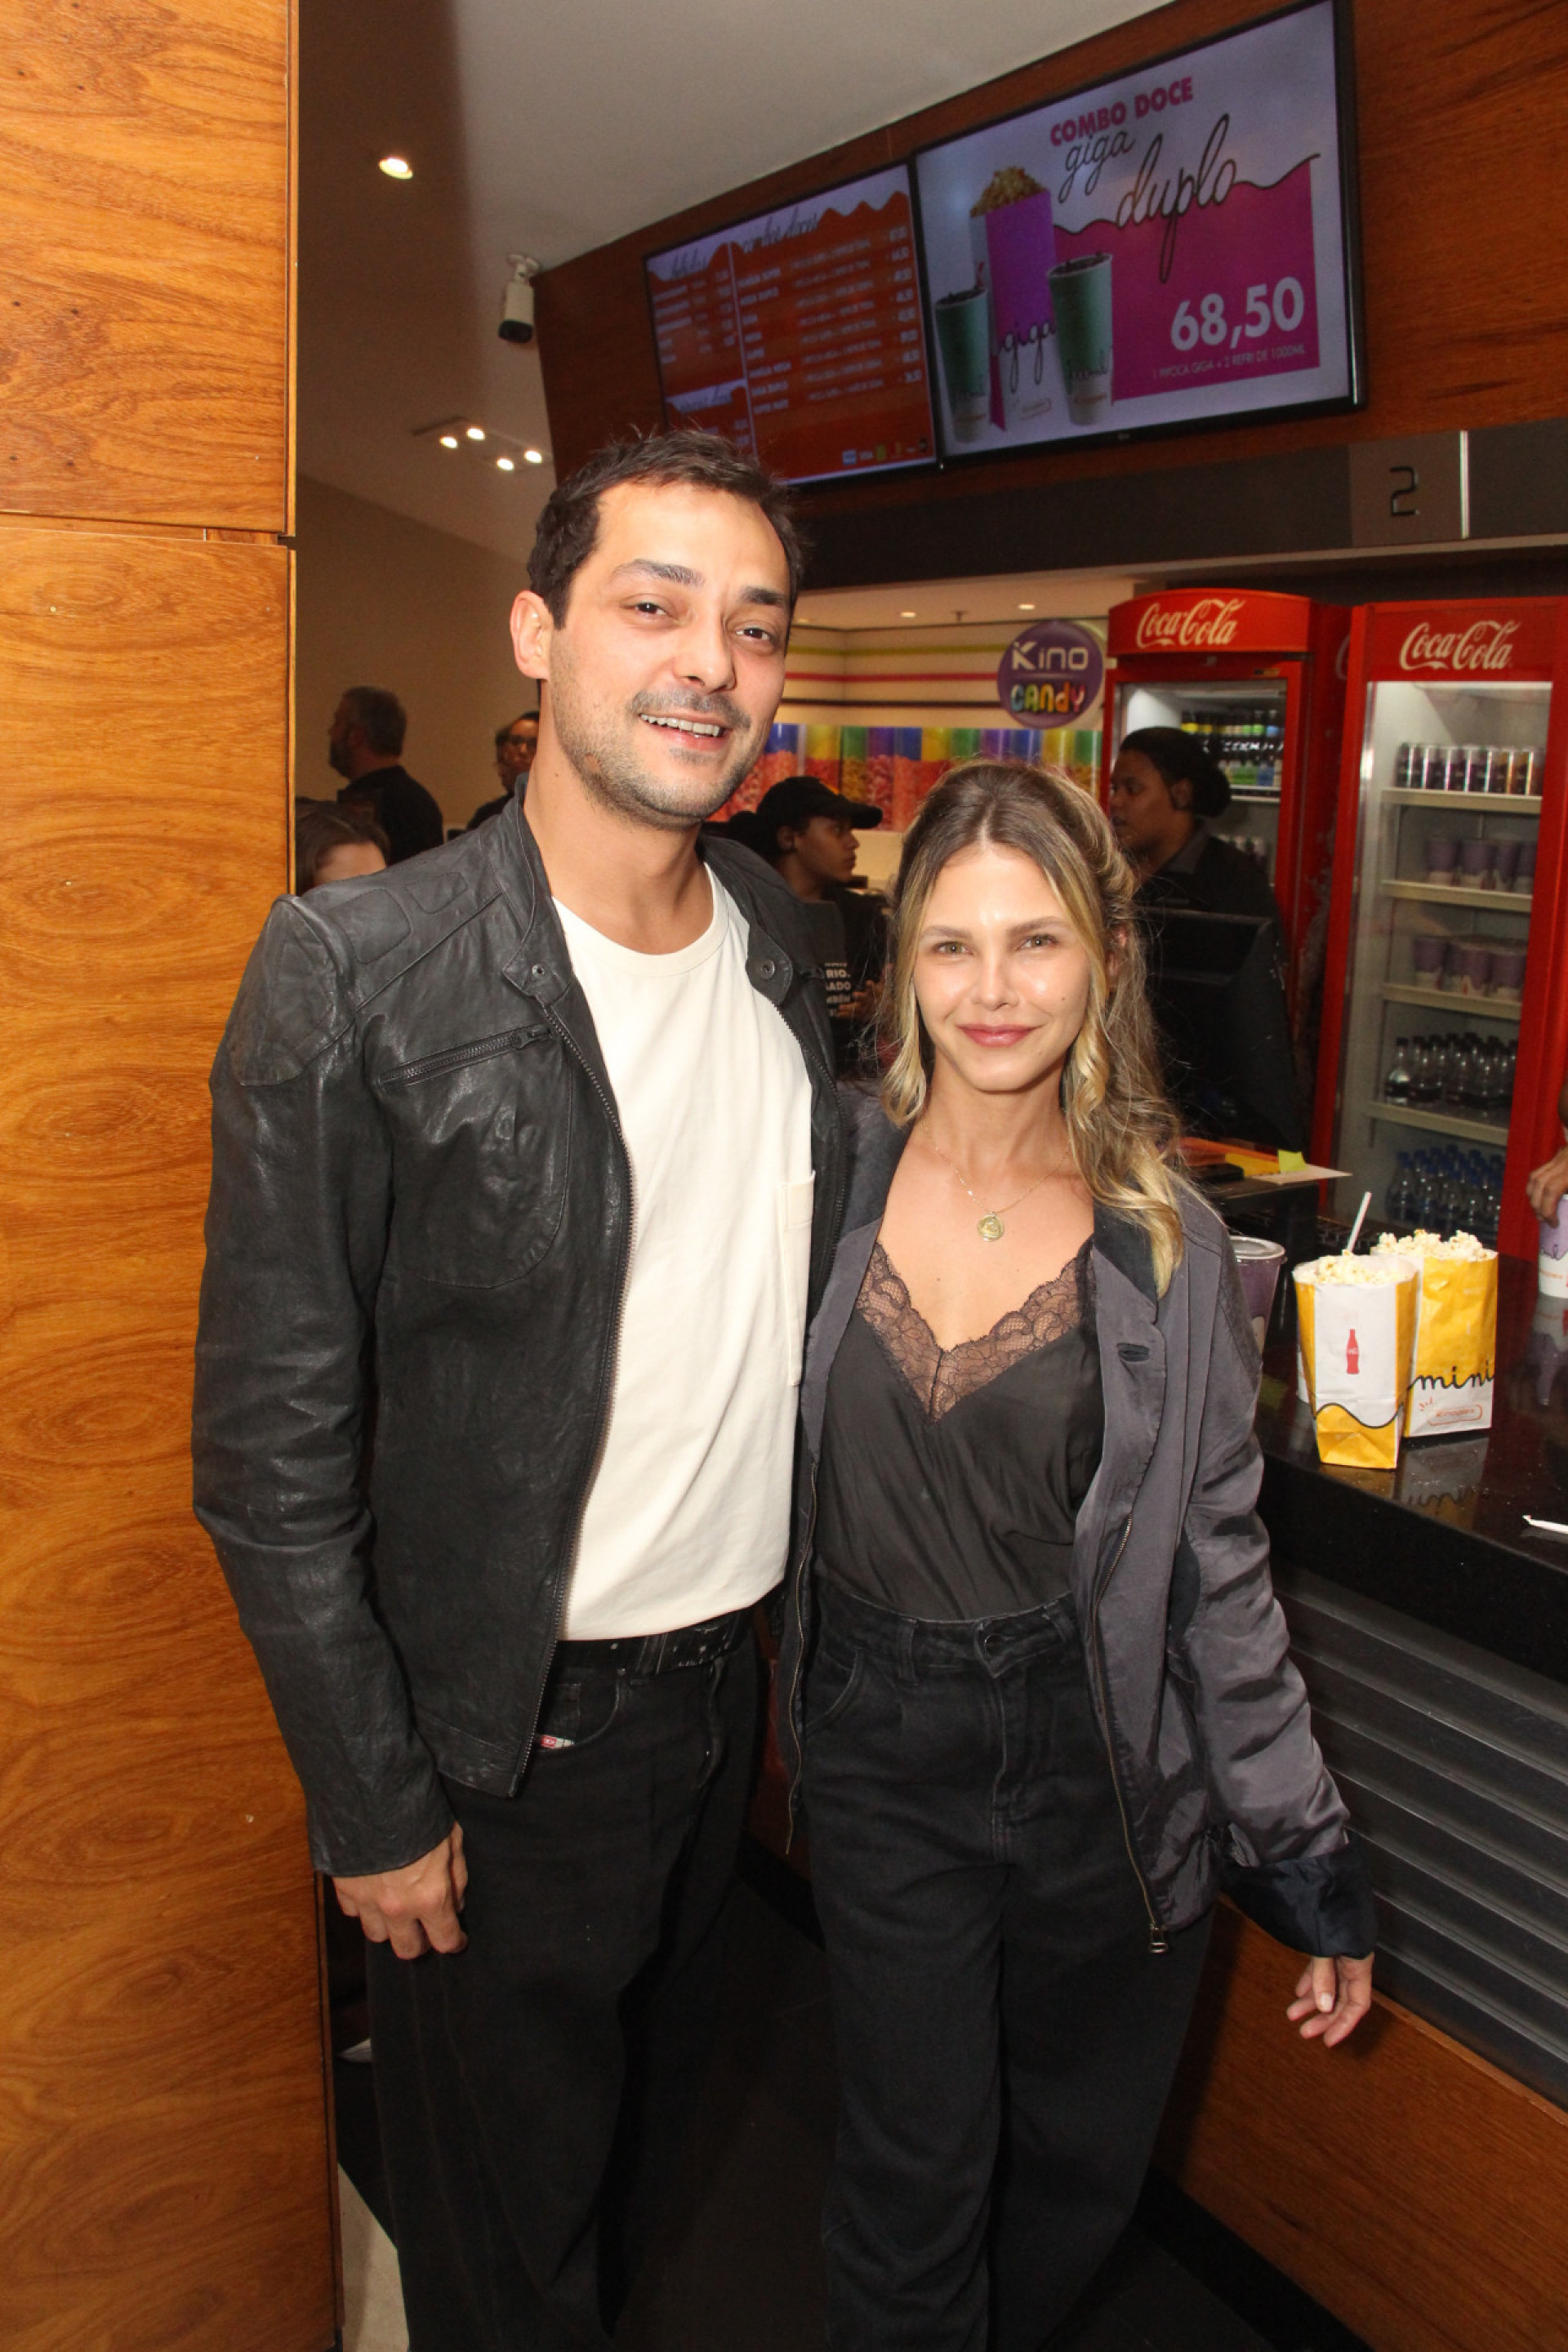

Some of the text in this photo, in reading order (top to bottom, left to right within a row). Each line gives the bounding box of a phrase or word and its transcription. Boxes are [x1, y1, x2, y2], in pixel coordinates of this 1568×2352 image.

[1050, 77, 1194, 147] COMBO DOCE
[1058, 129, 1135, 203] giga
[1116, 113, 1238, 283] duplo
[1170, 277, 1304, 351] 68,50
[1391, 465, 1420, 516] 2
[1136, 598, 1245, 648] Coca-Cola
[1399, 619, 1521, 670] Coca-Cola
[1012, 641, 1089, 670] Kino
[1408, 1359, 1495, 1390] mini
